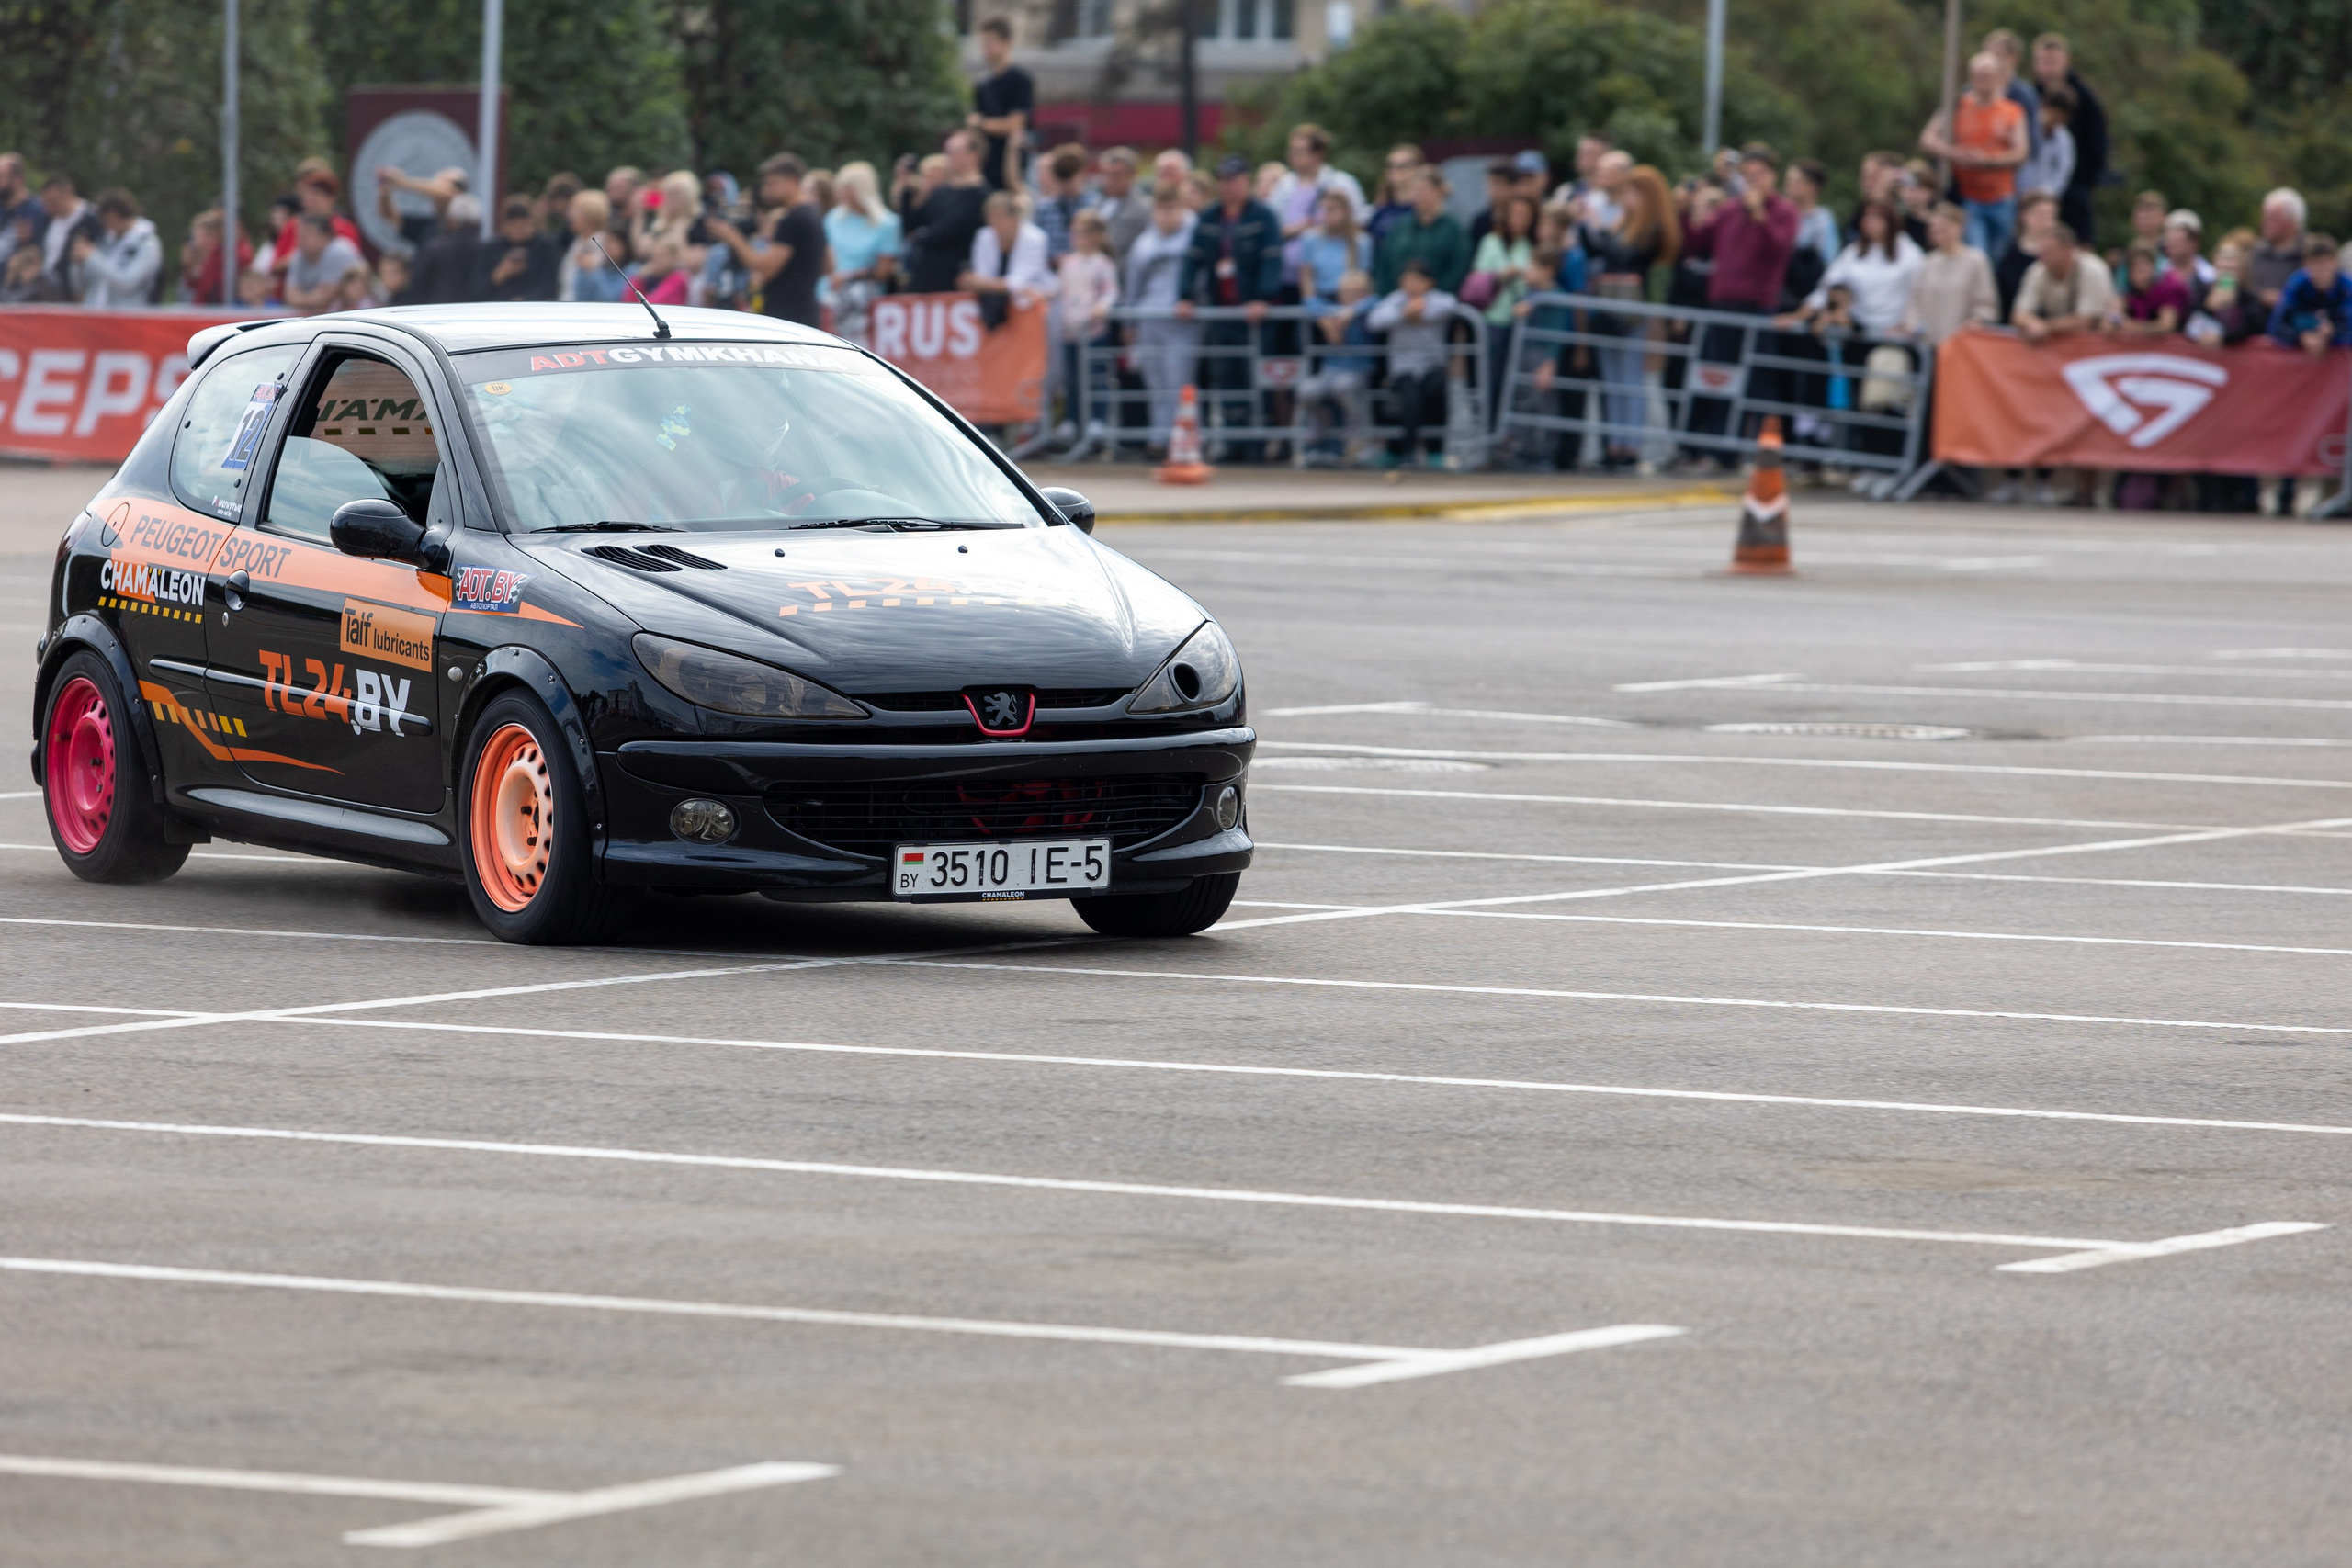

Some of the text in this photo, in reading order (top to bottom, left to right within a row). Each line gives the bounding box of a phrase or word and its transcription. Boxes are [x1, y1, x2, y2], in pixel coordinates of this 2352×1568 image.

[875, 299, 981, 360] RUS
[531, 346, 848, 371] ADTGYMKHANA
[229, 409, 266, 462] 12
[130, 515, 292, 578] PEUGEOT SPORT
[458, 567, 527, 604] ADT.BY
[345, 608, 430, 661] Taif lubricants
[259, 649, 411, 737] TL24.BY
[900, 845, 1102, 888] BY 3510 IE-5
